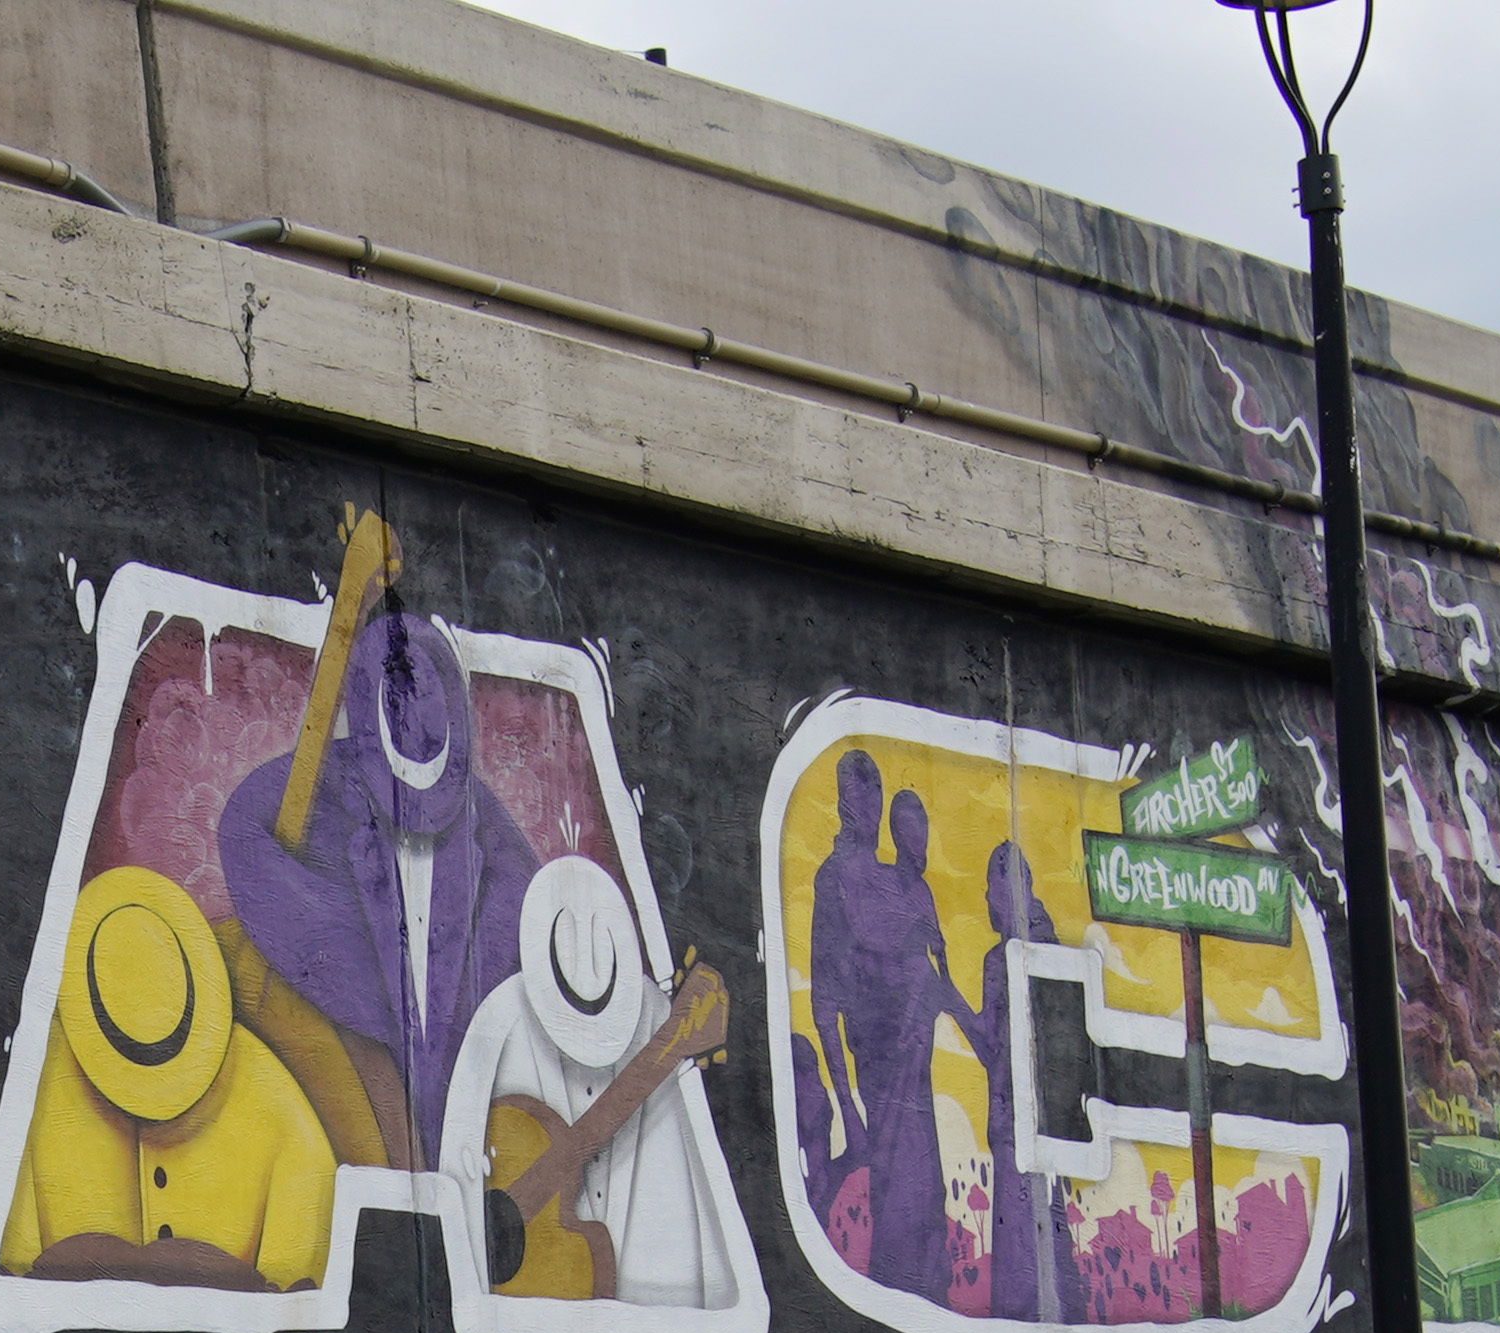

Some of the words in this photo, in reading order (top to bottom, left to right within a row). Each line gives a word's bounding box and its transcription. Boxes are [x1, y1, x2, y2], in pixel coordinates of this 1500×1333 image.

[1132, 755, 1231, 835] ARCHER
[1210, 738, 1240, 782] ST
[1227, 771, 1258, 810] 500
[1096, 854, 1109, 893] N
[1109, 844, 1258, 916] GREENWOOD
[1257, 866, 1280, 895] AV
